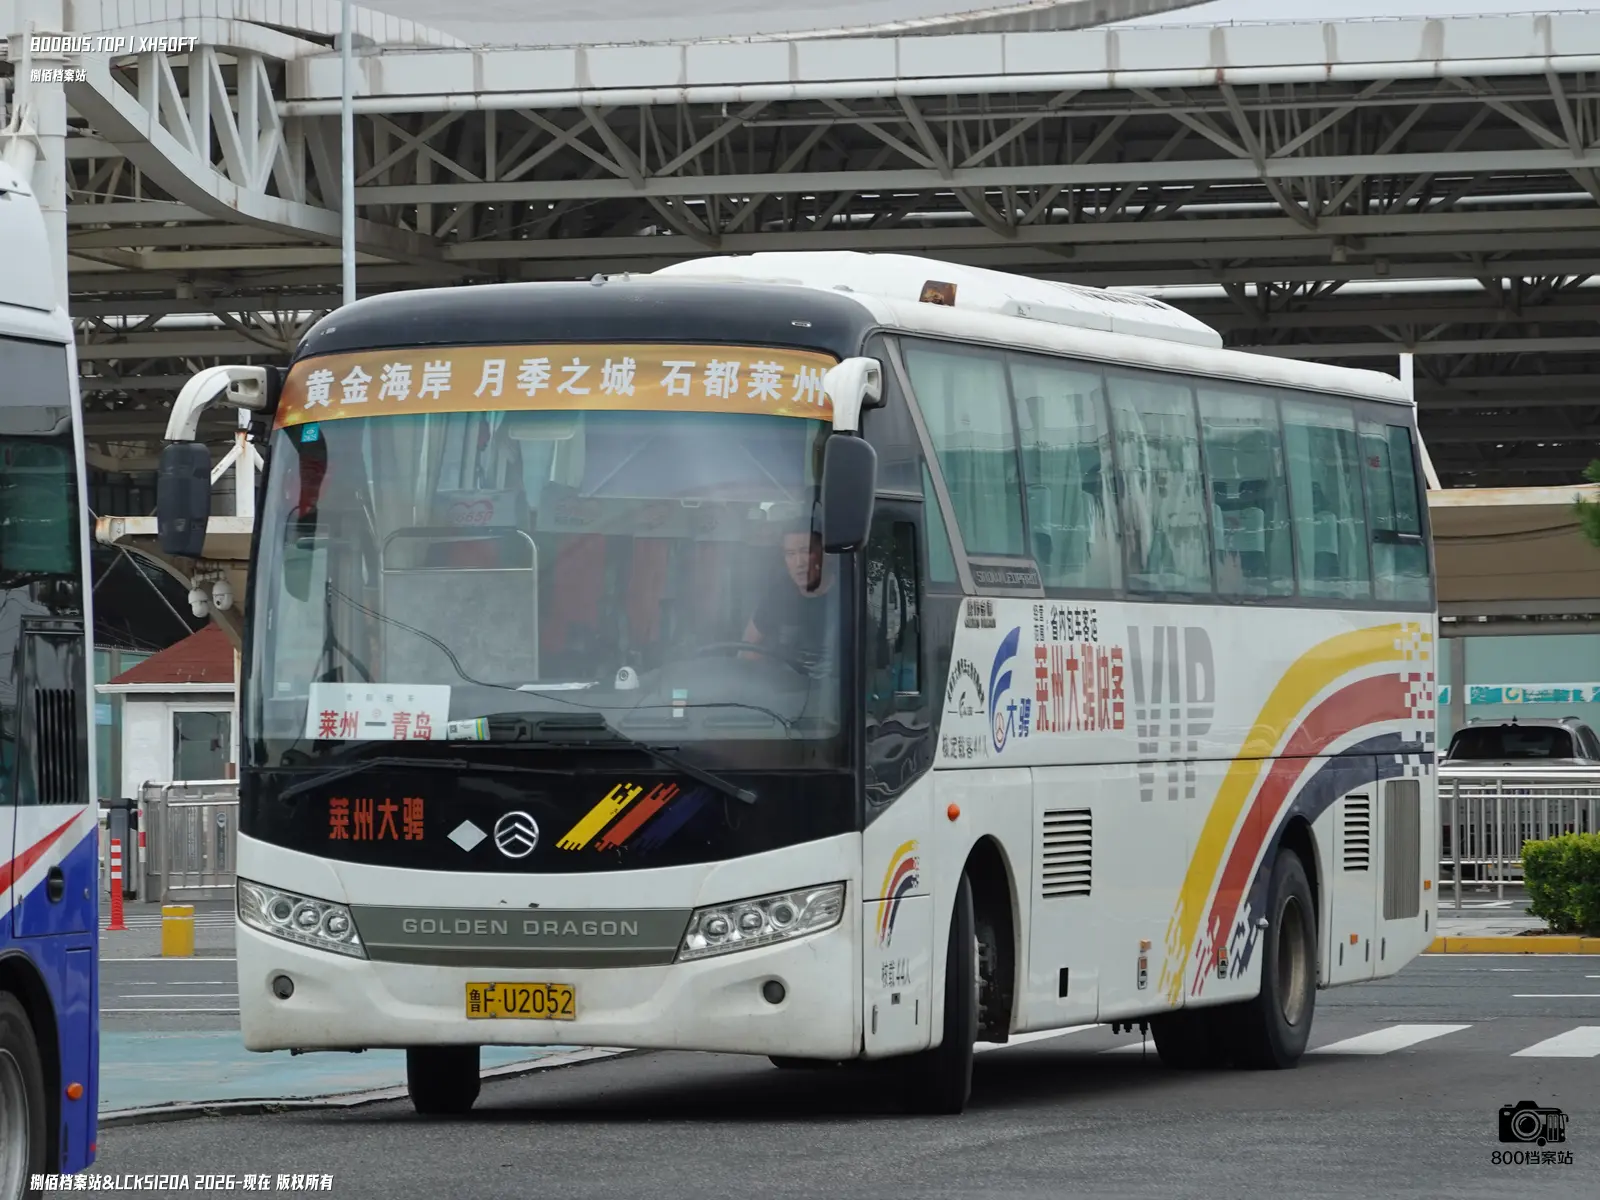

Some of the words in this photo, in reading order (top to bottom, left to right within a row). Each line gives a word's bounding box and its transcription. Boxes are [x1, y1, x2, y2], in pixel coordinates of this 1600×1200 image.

[303, 360, 453, 409] 黄金海岸
[473, 356, 637, 399] 月季之城
[660, 358, 827, 406] 石都莱州
[1034, 643, 1125, 732] 莱州大骋快客
[1127, 626, 1215, 802] VIP
[328, 797, 425, 841] 莱州大骋
[402, 918, 508, 936] GOLDEN
[522, 919, 639, 936] DRAGON
